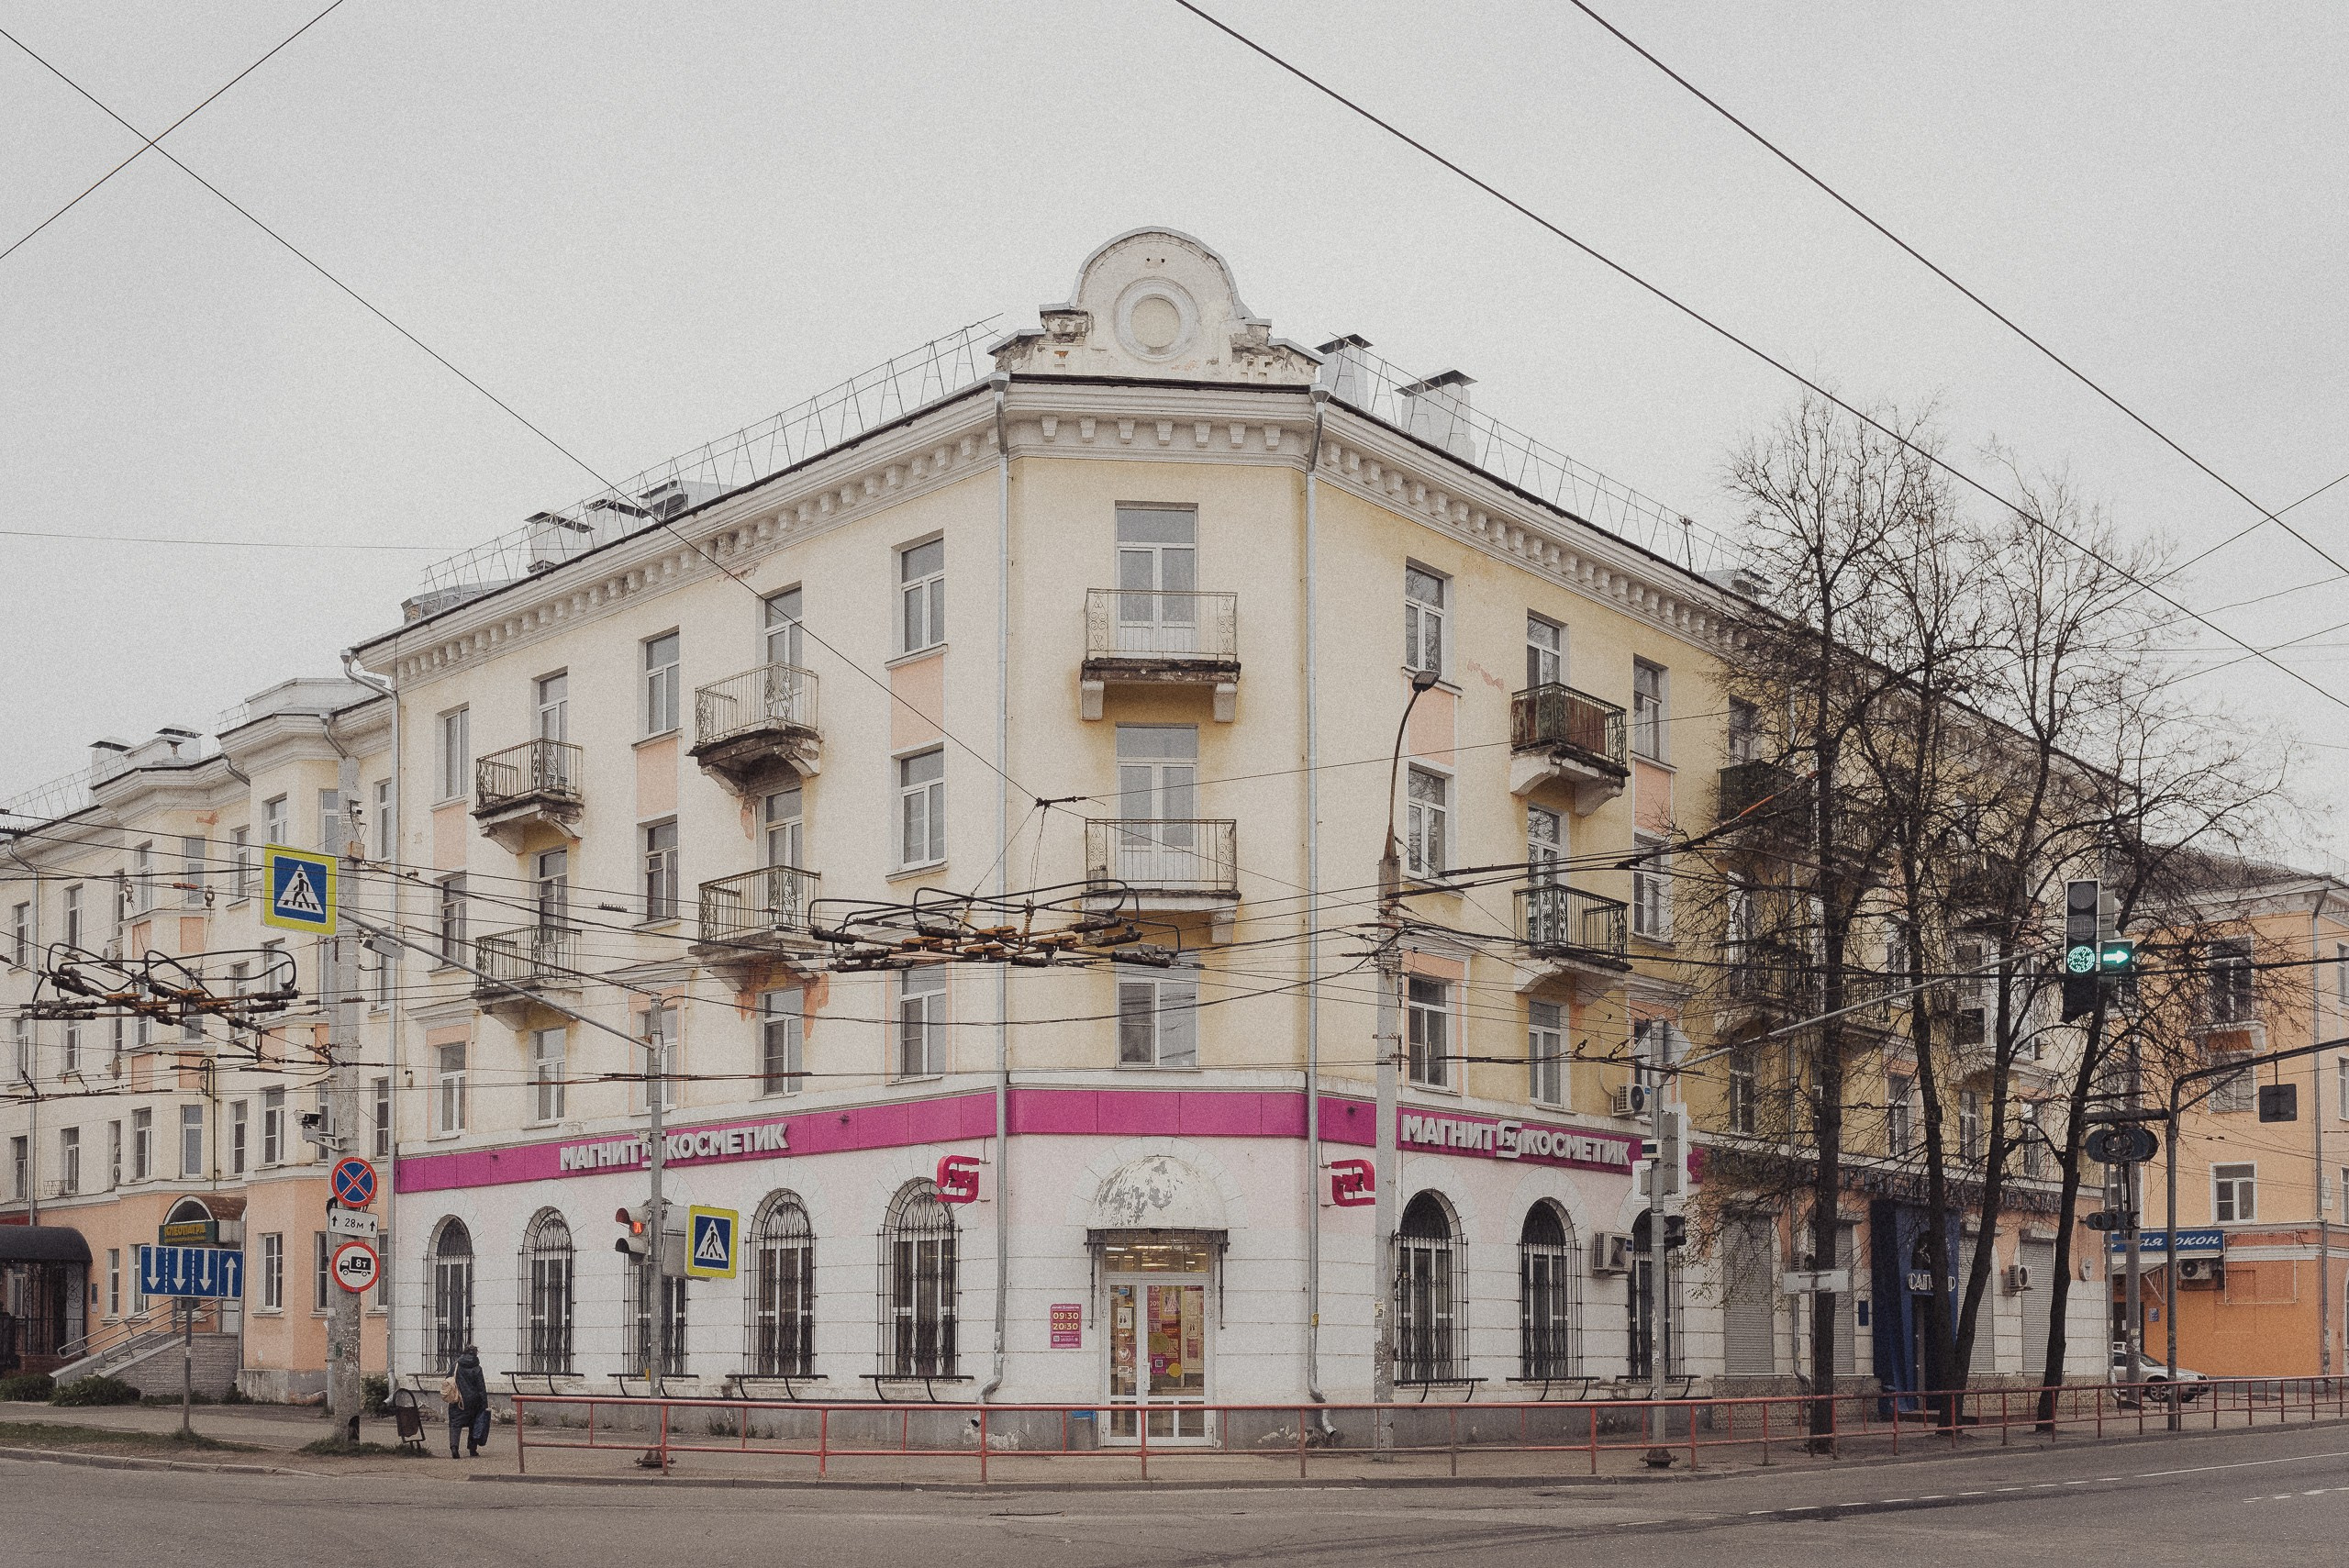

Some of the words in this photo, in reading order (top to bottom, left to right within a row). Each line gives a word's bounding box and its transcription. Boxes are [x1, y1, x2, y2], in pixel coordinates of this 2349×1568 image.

[560, 1139, 640, 1171] МАГНИТ
[666, 1122, 789, 1161] КОСМЕТИК
[1400, 1114, 1497, 1151] МАГНИТ
[1520, 1129, 1631, 1166] КОСМЕТИК
[1052, 1312, 1079, 1320] 09:30
[1052, 1322, 1079, 1330] 20:30
